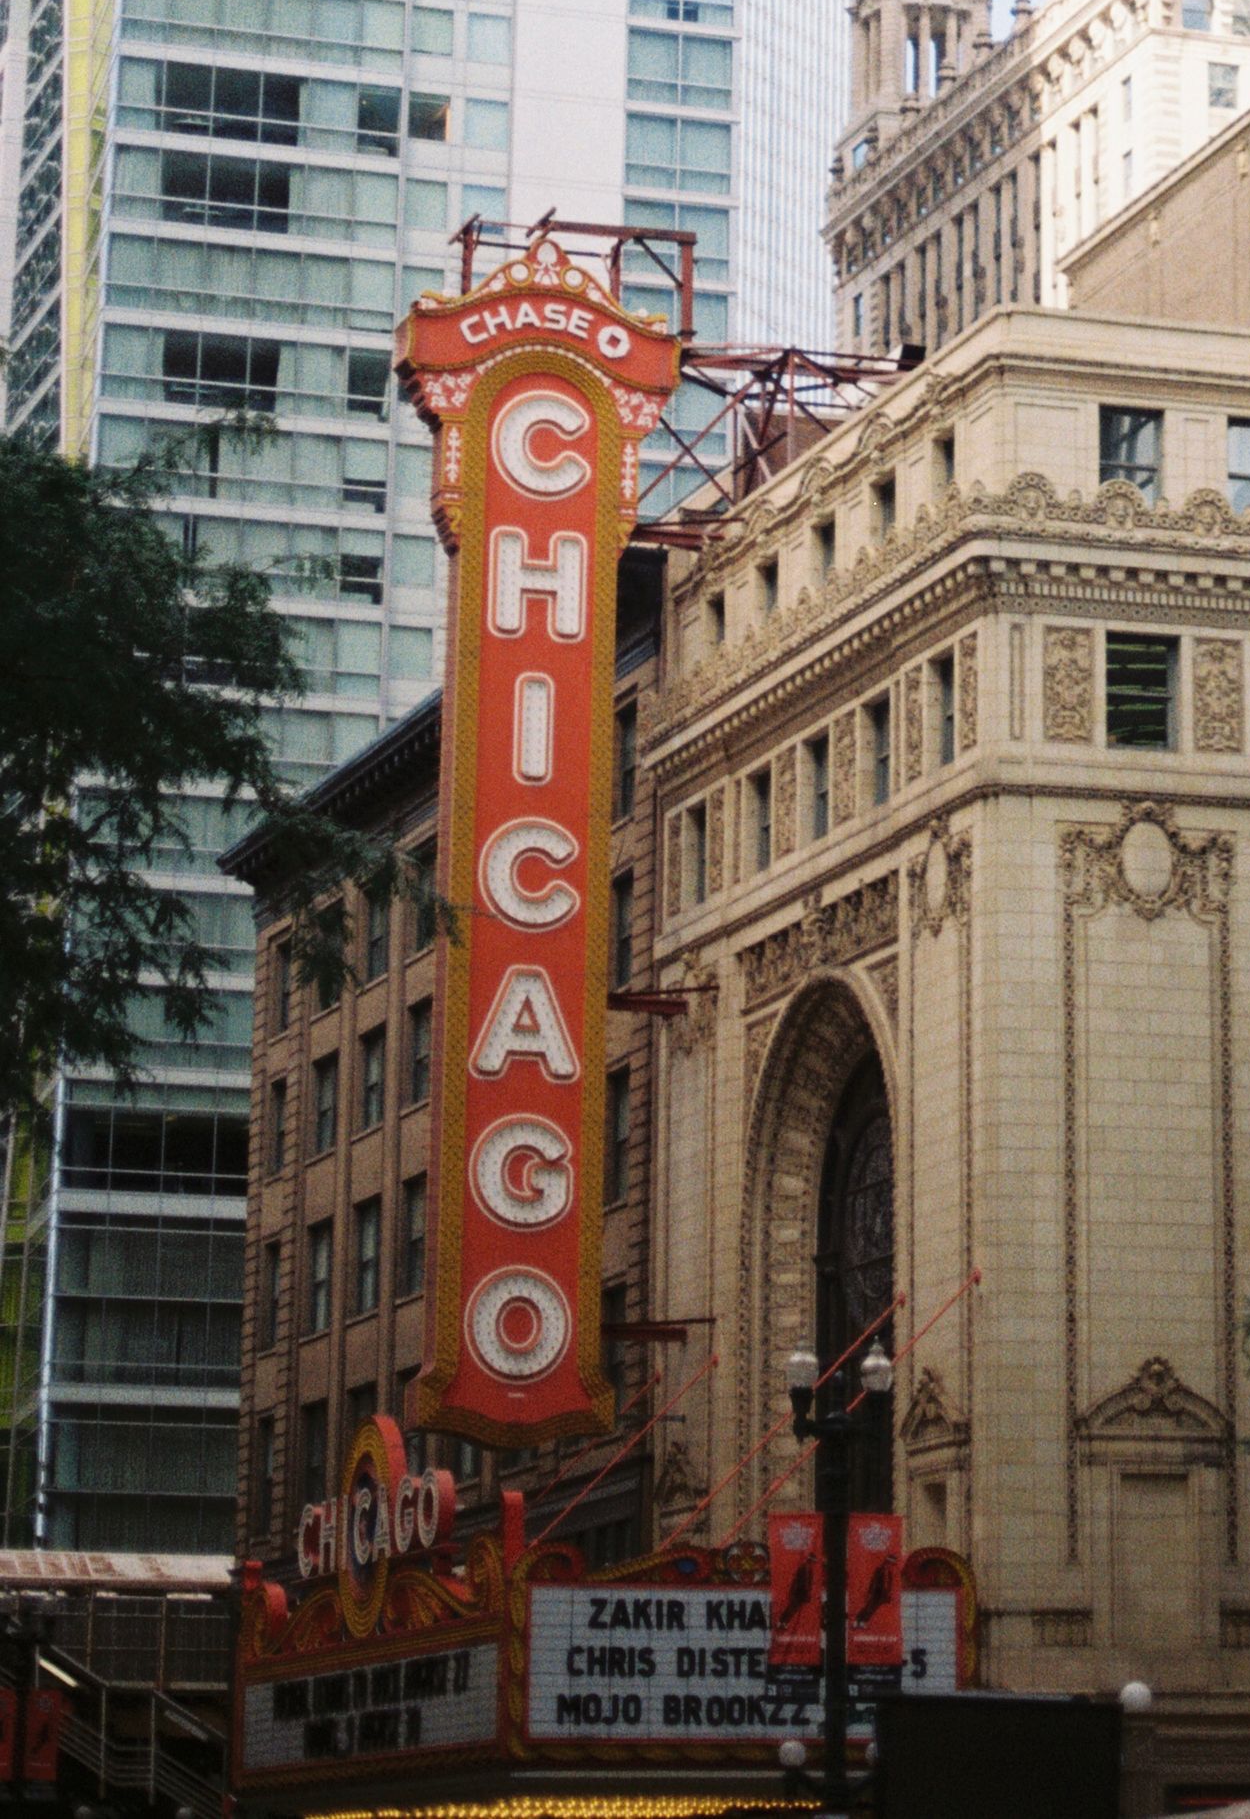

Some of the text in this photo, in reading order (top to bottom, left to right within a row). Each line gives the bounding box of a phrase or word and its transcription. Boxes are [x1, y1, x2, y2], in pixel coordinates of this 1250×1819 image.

[460, 301, 595, 346] CHASE
[463, 389, 592, 1385] CHICAGO
[296, 1467, 441, 1579] CHICAGO
[588, 1598, 772, 1631] ZAKIR KHA
[566, 1647, 657, 1679] CHRIS
[677, 1647, 769, 1679] DISTE
[557, 1693, 642, 1727] MOJO
[663, 1693, 812, 1727] BROOKZZ
